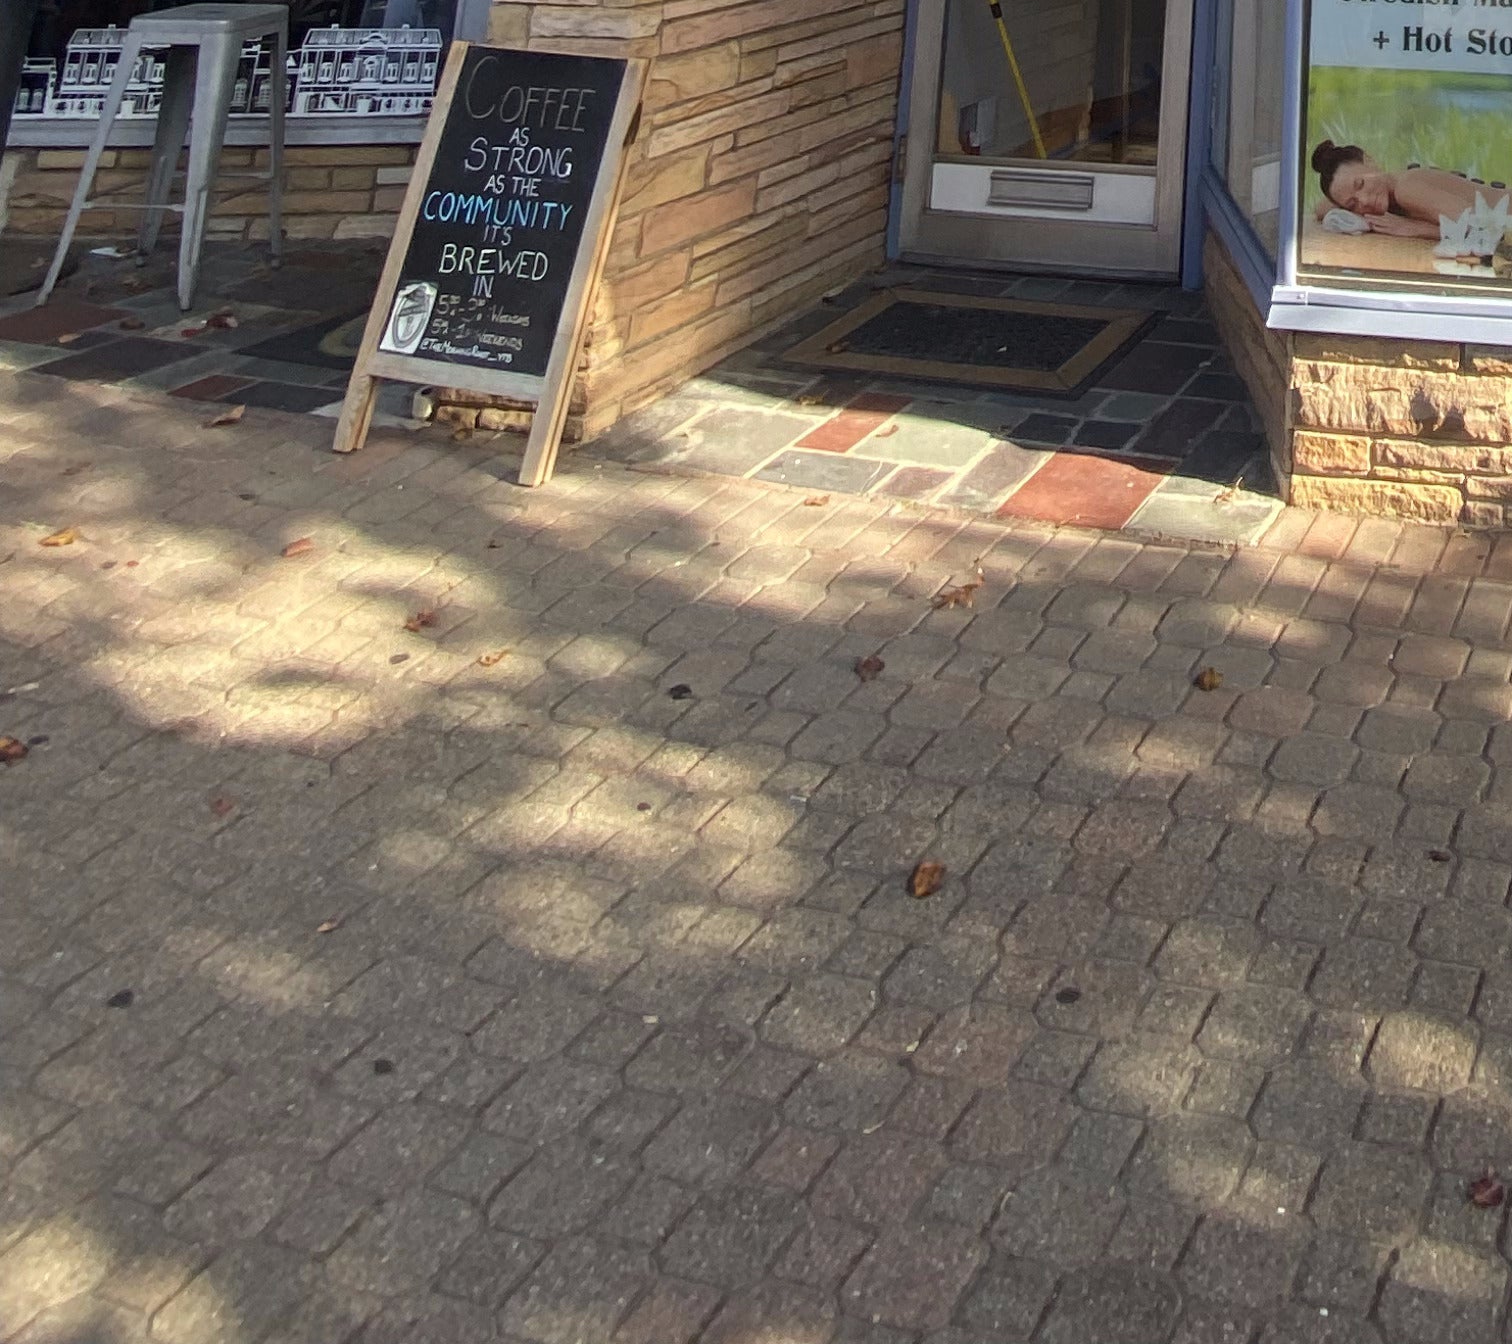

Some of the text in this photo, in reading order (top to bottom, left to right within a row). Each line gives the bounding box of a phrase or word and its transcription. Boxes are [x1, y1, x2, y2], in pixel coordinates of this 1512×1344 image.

[1402, 25, 1453, 53] Hot
[466, 55, 596, 133] COFFEE
[509, 127, 530, 147] AS
[465, 137, 573, 178] STRONG
[483, 174, 542, 197] AS THE
[424, 191, 573, 231] COMMUNITY
[439, 243, 548, 281] BREWED
[472, 276, 495, 298] IN
